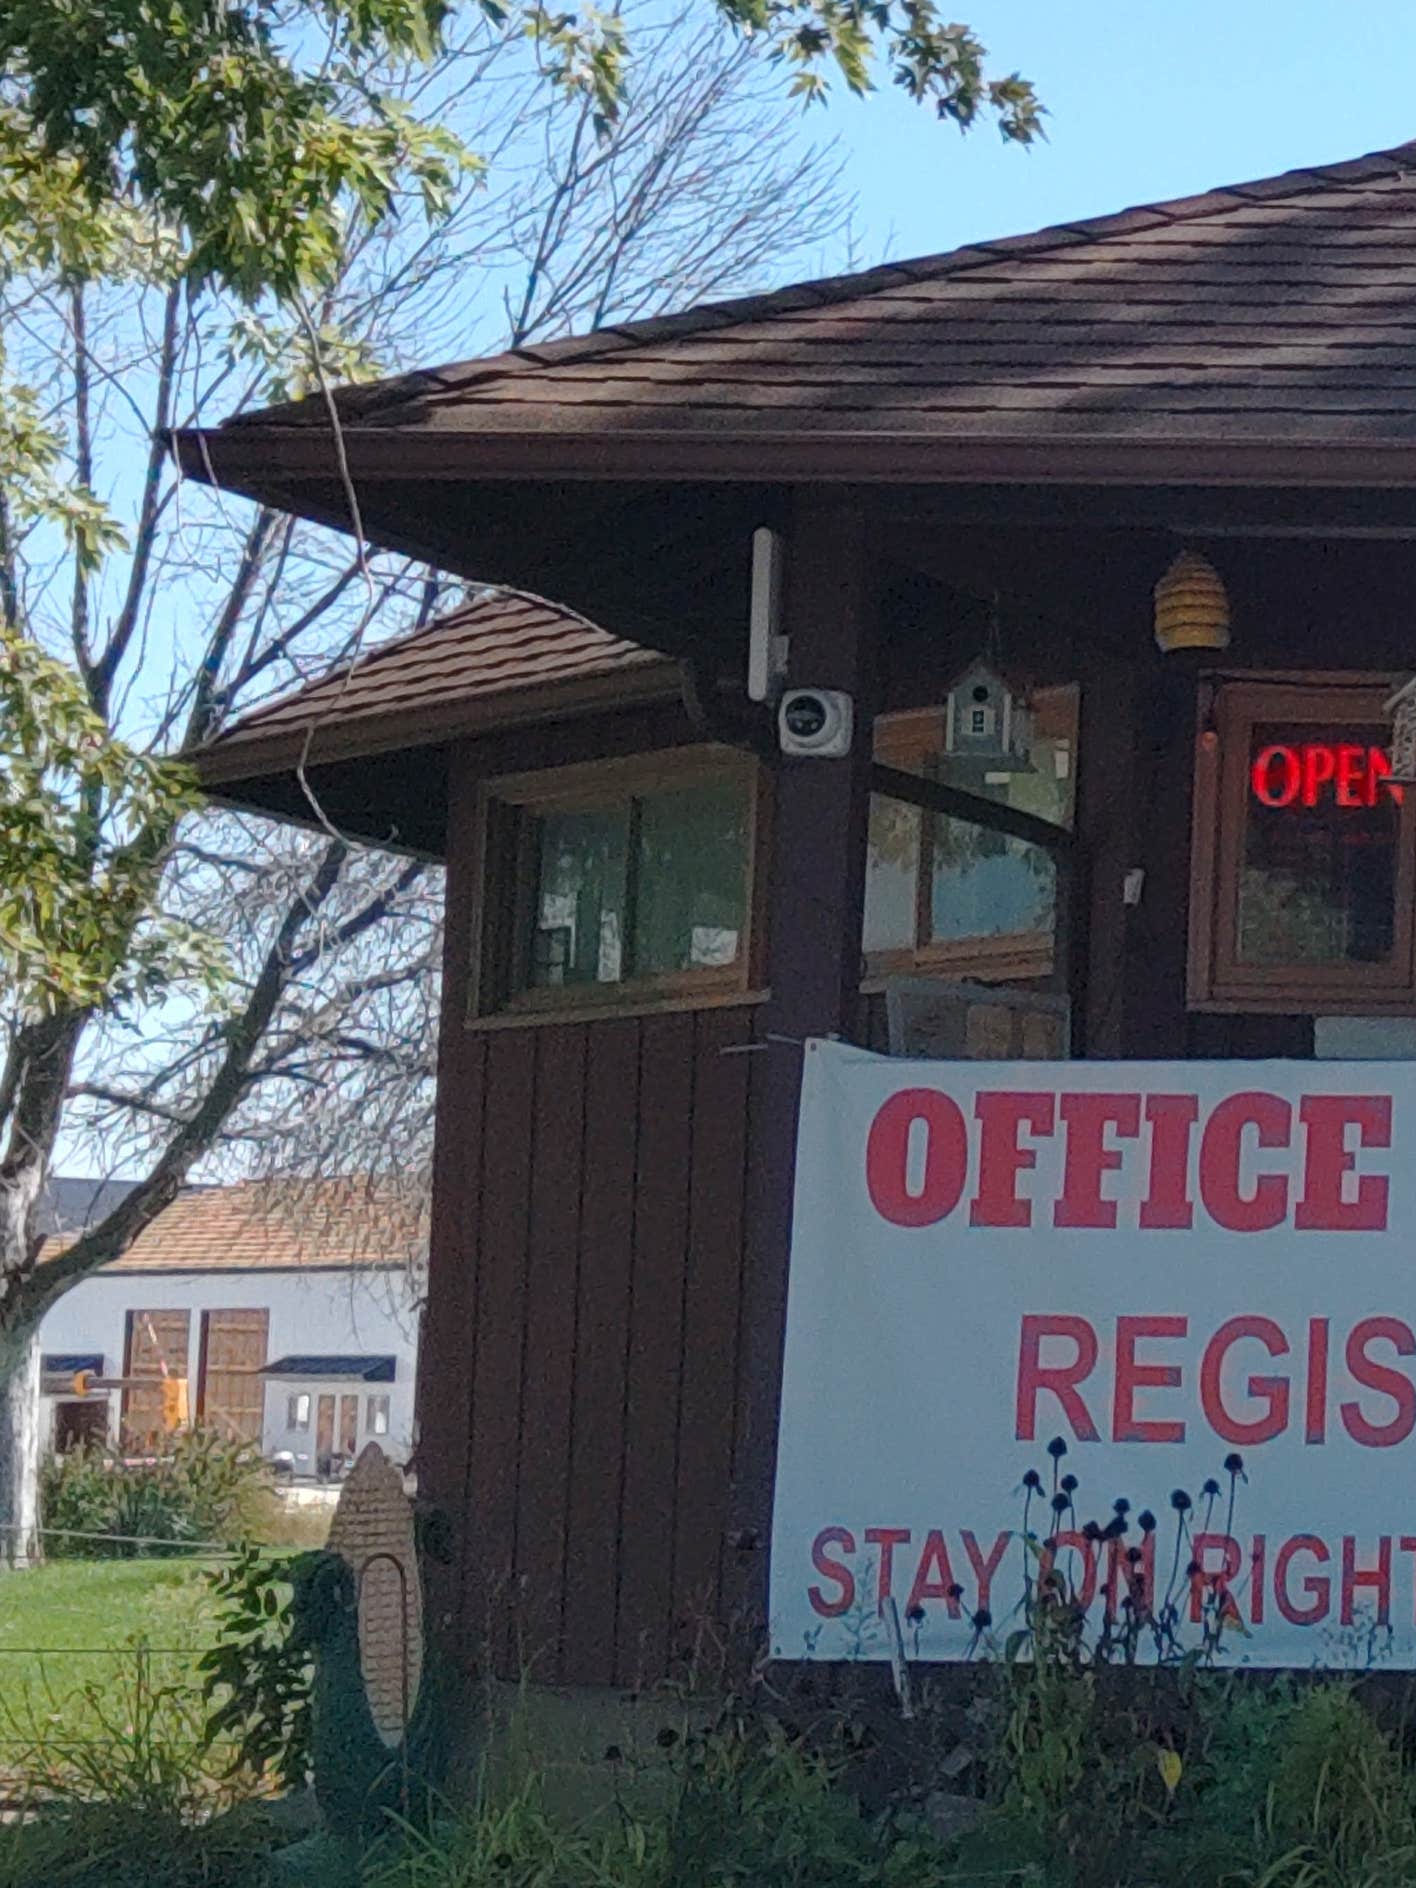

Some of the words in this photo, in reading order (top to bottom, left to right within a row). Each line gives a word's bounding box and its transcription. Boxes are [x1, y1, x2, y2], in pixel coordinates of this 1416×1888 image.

[1252, 744, 1405, 807] OPEN
[865, 1087, 1393, 1232] OFFICE
[808, 1526, 1011, 1621] STAY
[1040, 1530, 1157, 1625] ON
